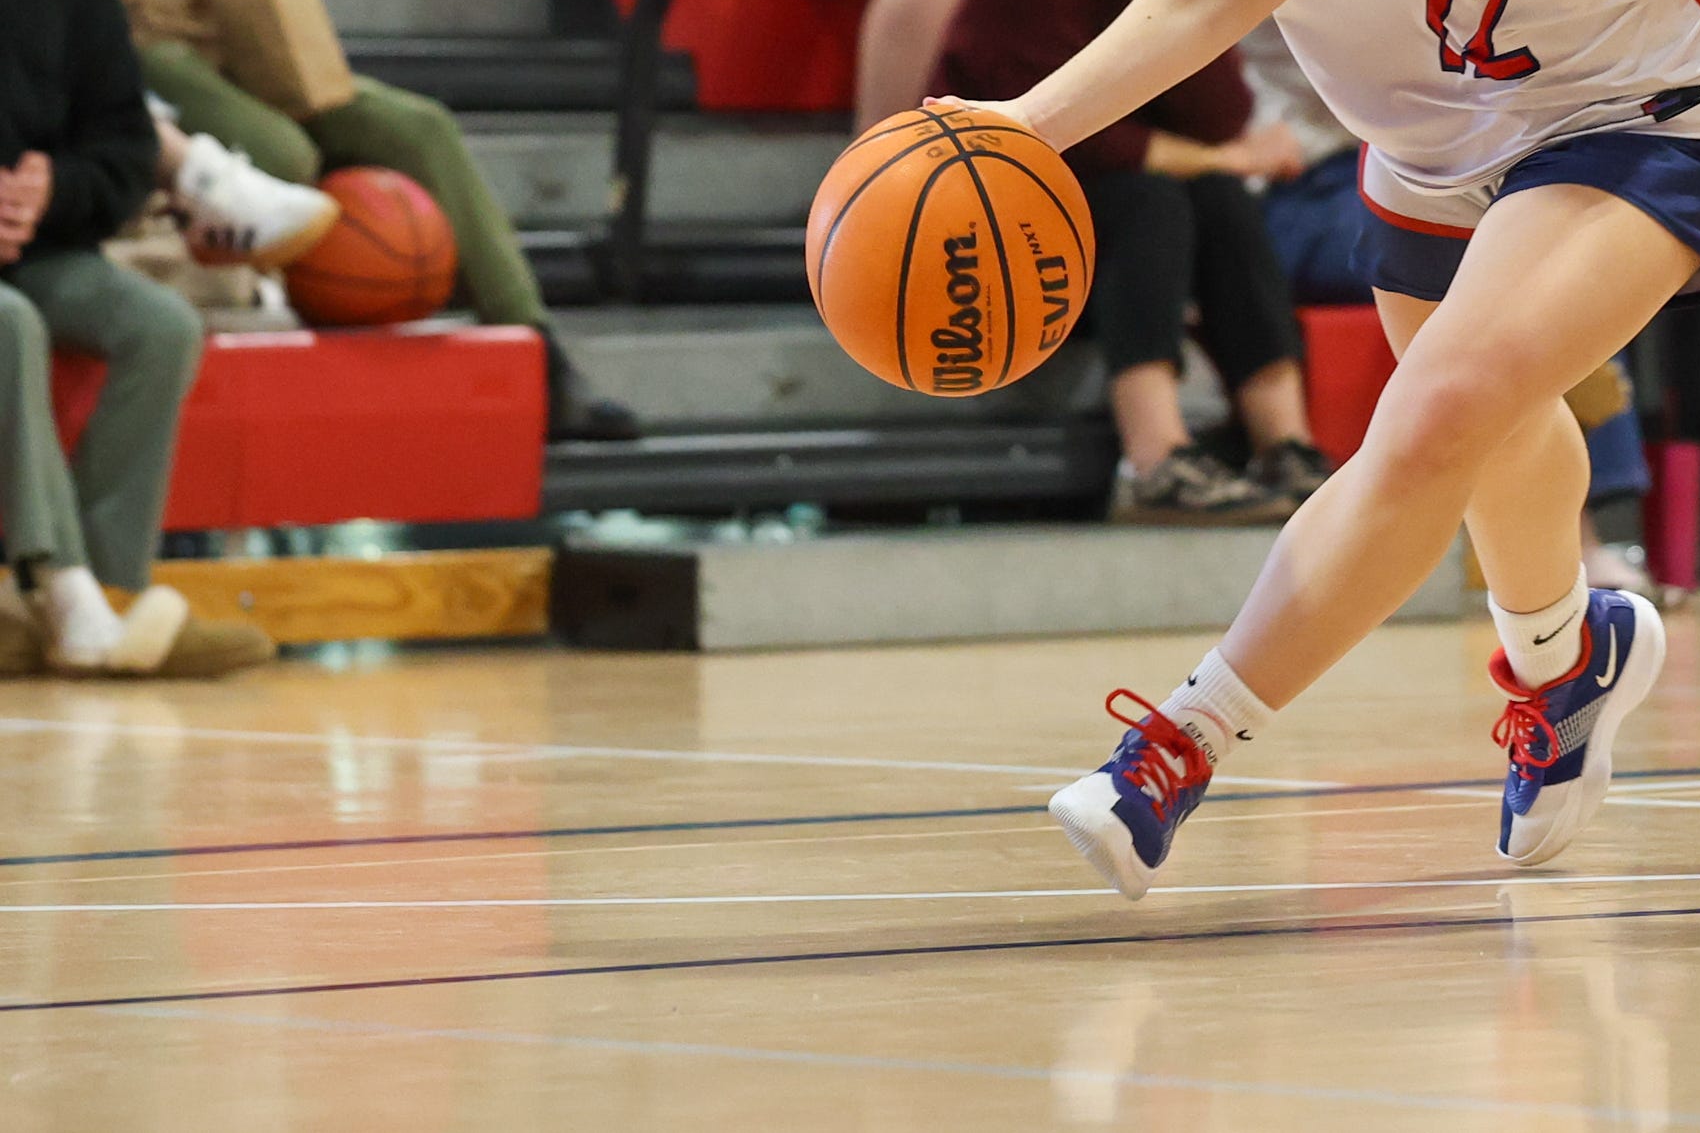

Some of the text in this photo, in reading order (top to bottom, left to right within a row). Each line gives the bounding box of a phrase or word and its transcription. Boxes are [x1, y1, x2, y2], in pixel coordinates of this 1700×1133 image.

[930, 232, 984, 393] Wilson
[1018, 221, 1070, 352] EVO NXT
